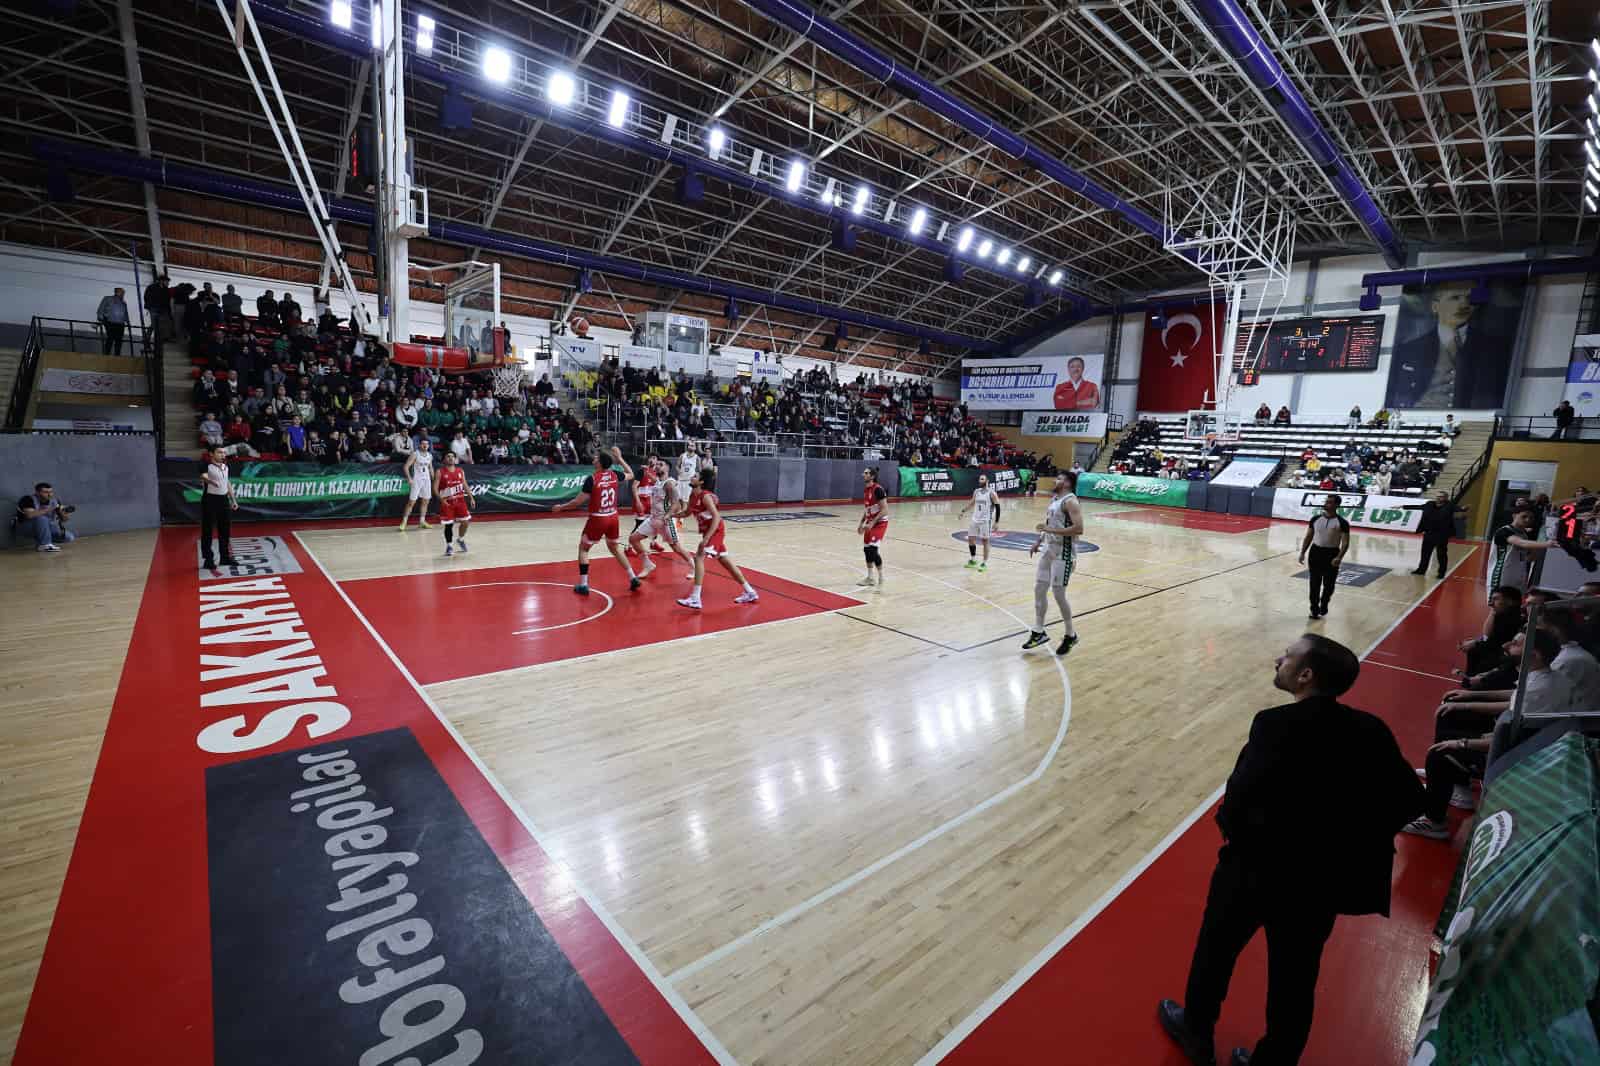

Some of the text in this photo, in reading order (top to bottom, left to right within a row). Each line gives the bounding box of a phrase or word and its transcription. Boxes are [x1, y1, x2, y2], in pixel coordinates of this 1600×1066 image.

[569, 345, 586, 353] TV
[1037, 415, 1090, 425] BU SAHADA
[273, 481, 325, 497] RUHUYLA
[600, 487, 616, 508] 23
[1304, 494, 1362, 506] NEER
[1369, 508, 1413, 526] UP!
[197, 577, 351, 753] SAKARYA
